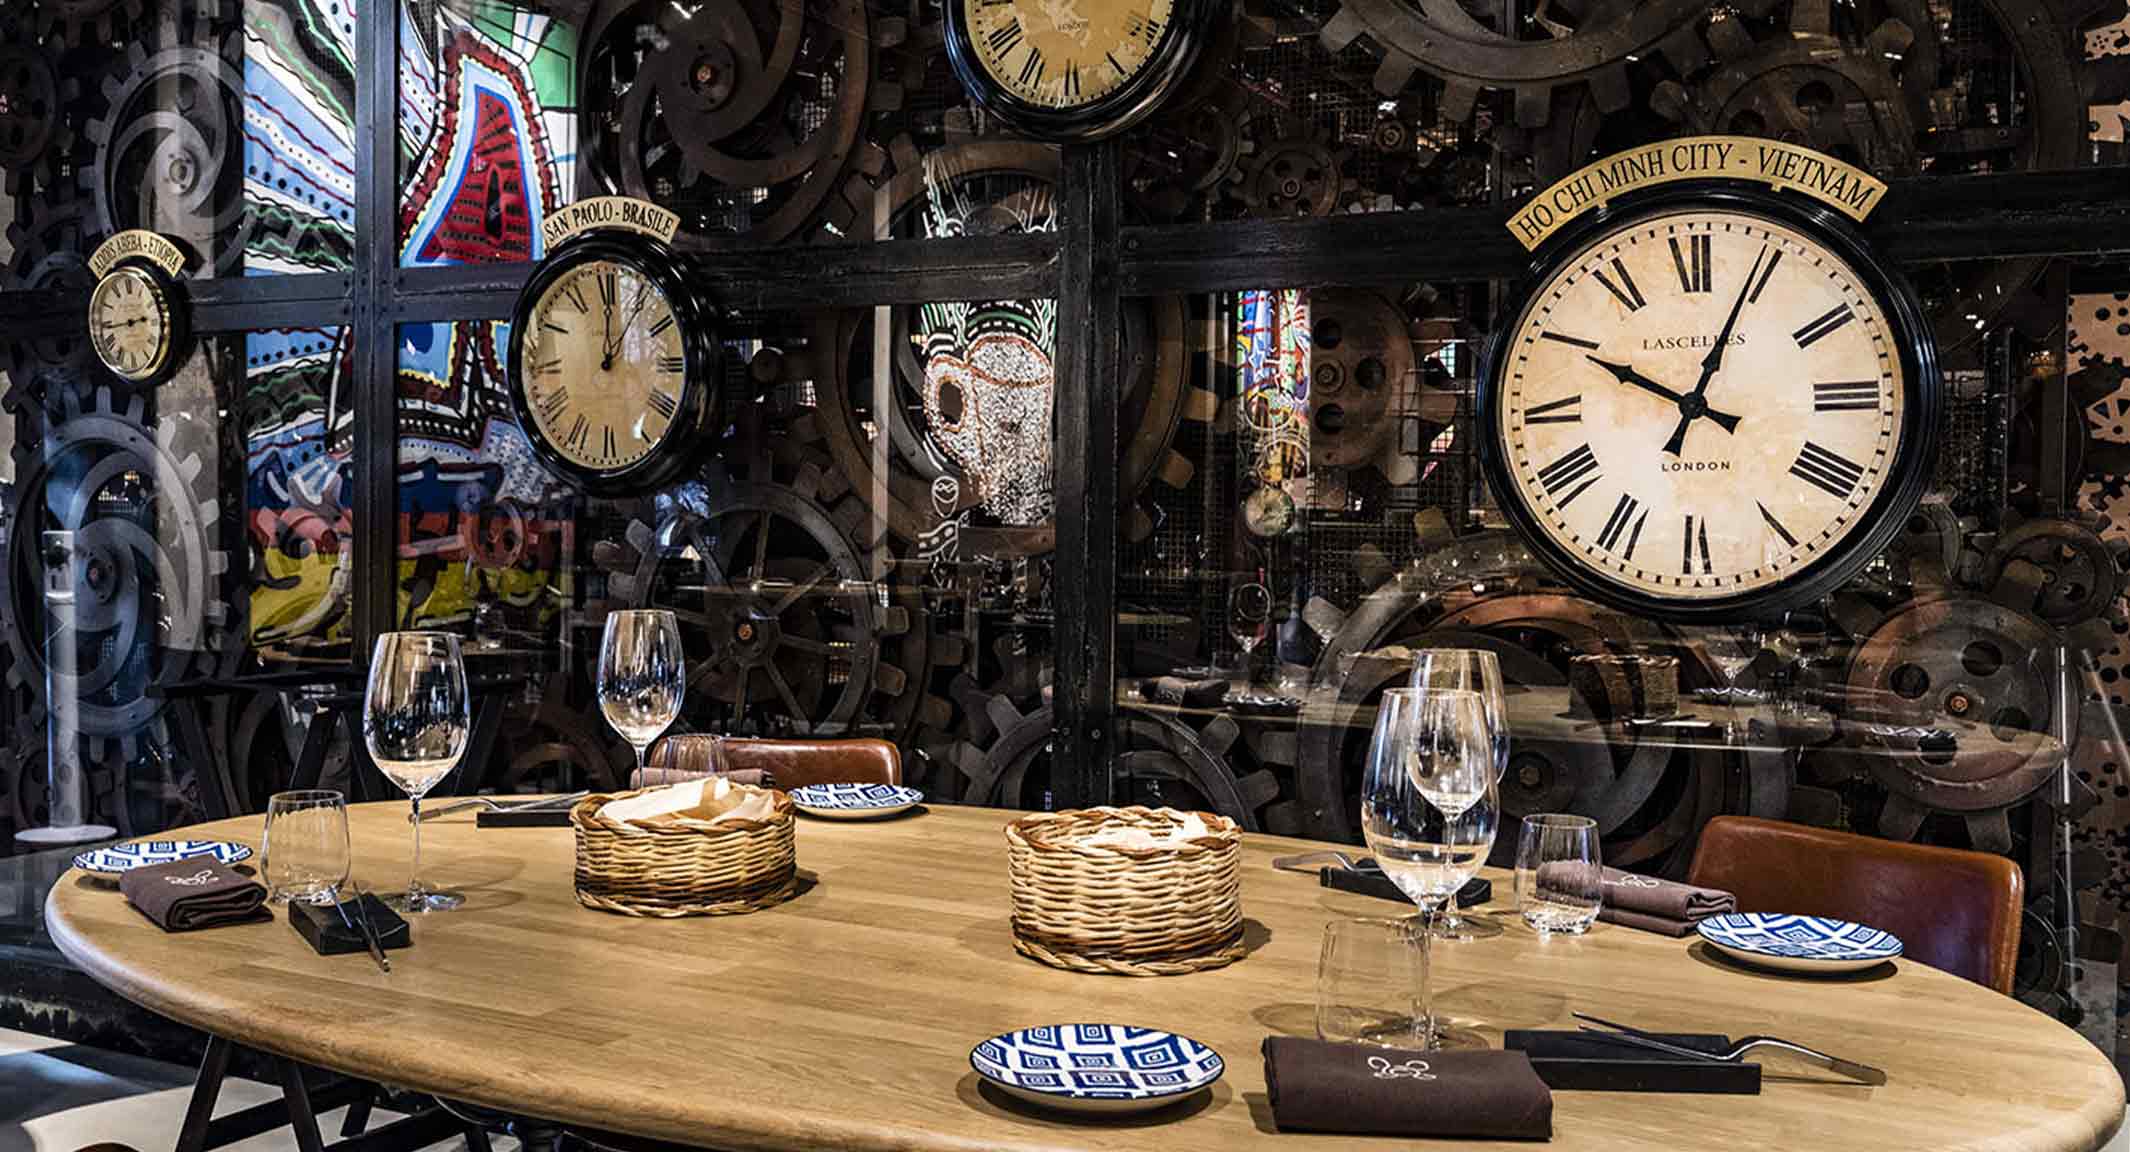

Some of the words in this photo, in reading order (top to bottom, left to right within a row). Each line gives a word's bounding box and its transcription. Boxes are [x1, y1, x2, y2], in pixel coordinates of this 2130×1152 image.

[1519, 204, 1554, 242] HO
[1555, 175, 1599, 213] CHI
[1598, 149, 1665, 193] MINH
[1672, 143, 1735, 172] CITY
[1758, 146, 1875, 211] VIETNAM
[544, 212, 571, 241] SAN
[572, 200, 613, 227] PAOLO
[622, 201, 675, 237] BRASILE
[1792, 301, 1858, 350] II
[1813, 380, 1881, 412] III
[1661, 461, 1730, 473] LONDON
